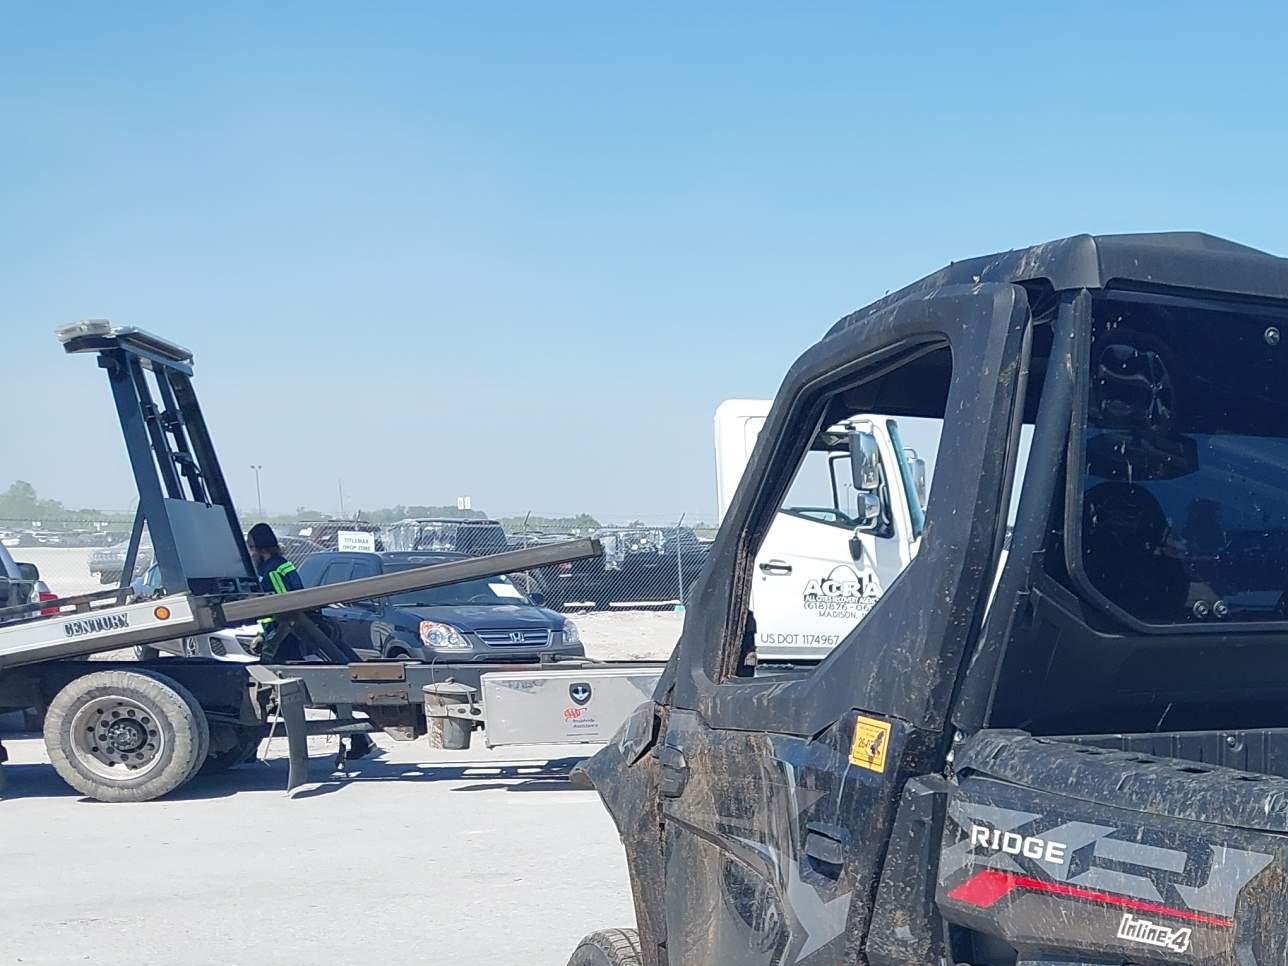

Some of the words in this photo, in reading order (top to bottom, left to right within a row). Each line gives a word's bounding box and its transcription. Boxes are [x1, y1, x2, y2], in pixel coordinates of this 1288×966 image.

[64, 612, 129, 638] CENTURY
[760, 633, 776, 644] US
[777, 633, 799, 645] DOT
[802, 634, 840, 645] 1174967
[970, 825, 1067, 864] RIDGE
